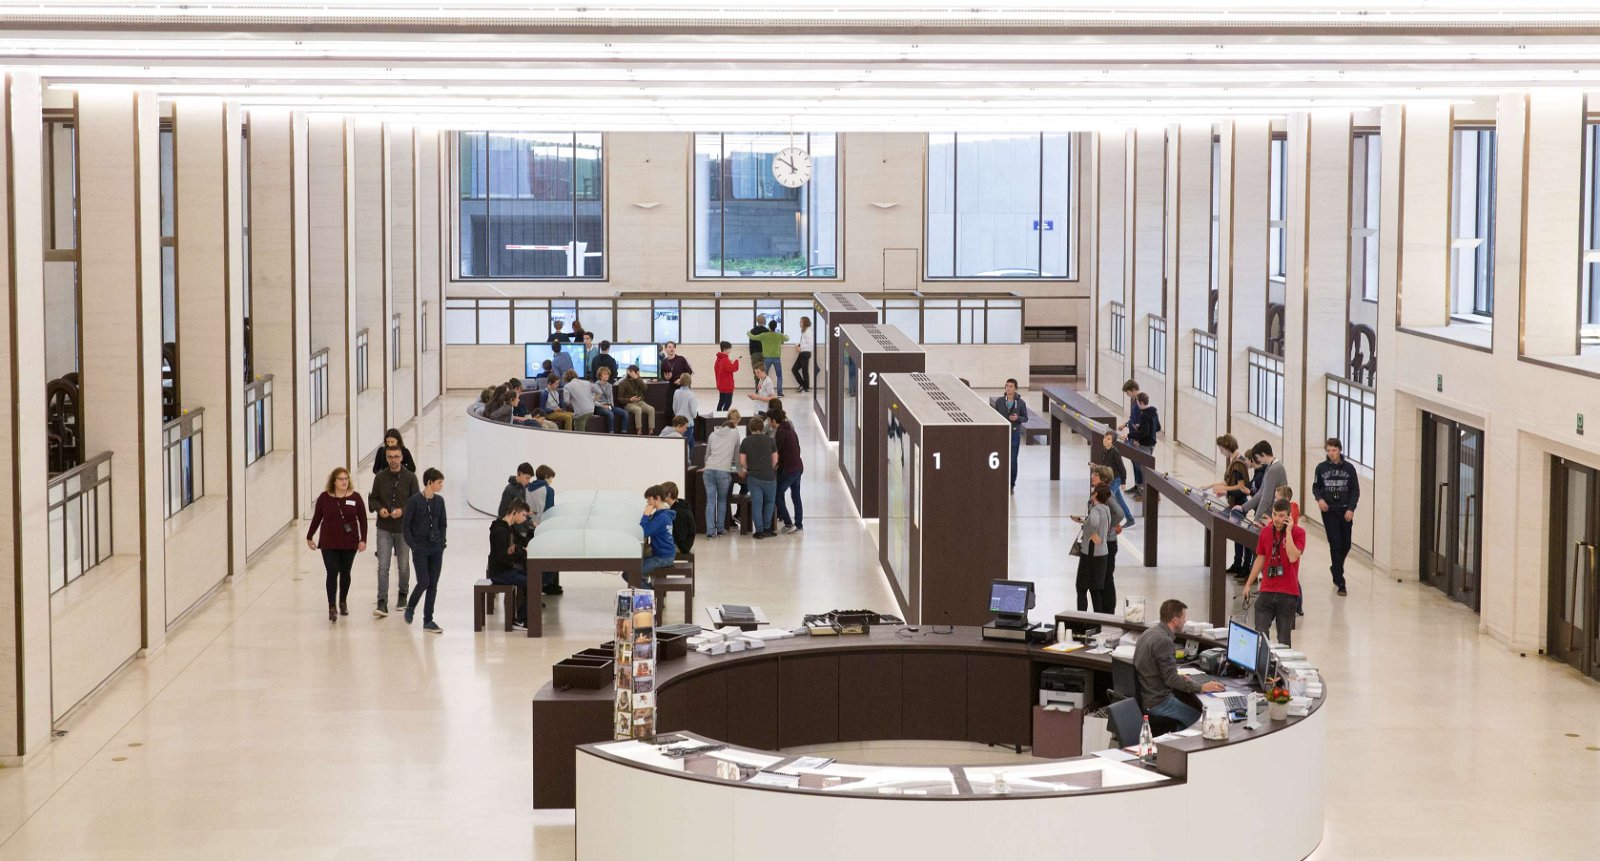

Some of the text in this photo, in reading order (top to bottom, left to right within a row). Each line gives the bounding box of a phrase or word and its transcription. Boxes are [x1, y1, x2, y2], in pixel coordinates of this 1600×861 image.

[834, 326, 840, 337] 3
[869, 372, 878, 385] 2
[932, 452, 941, 470] 1
[988, 451, 1000, 470] 6
